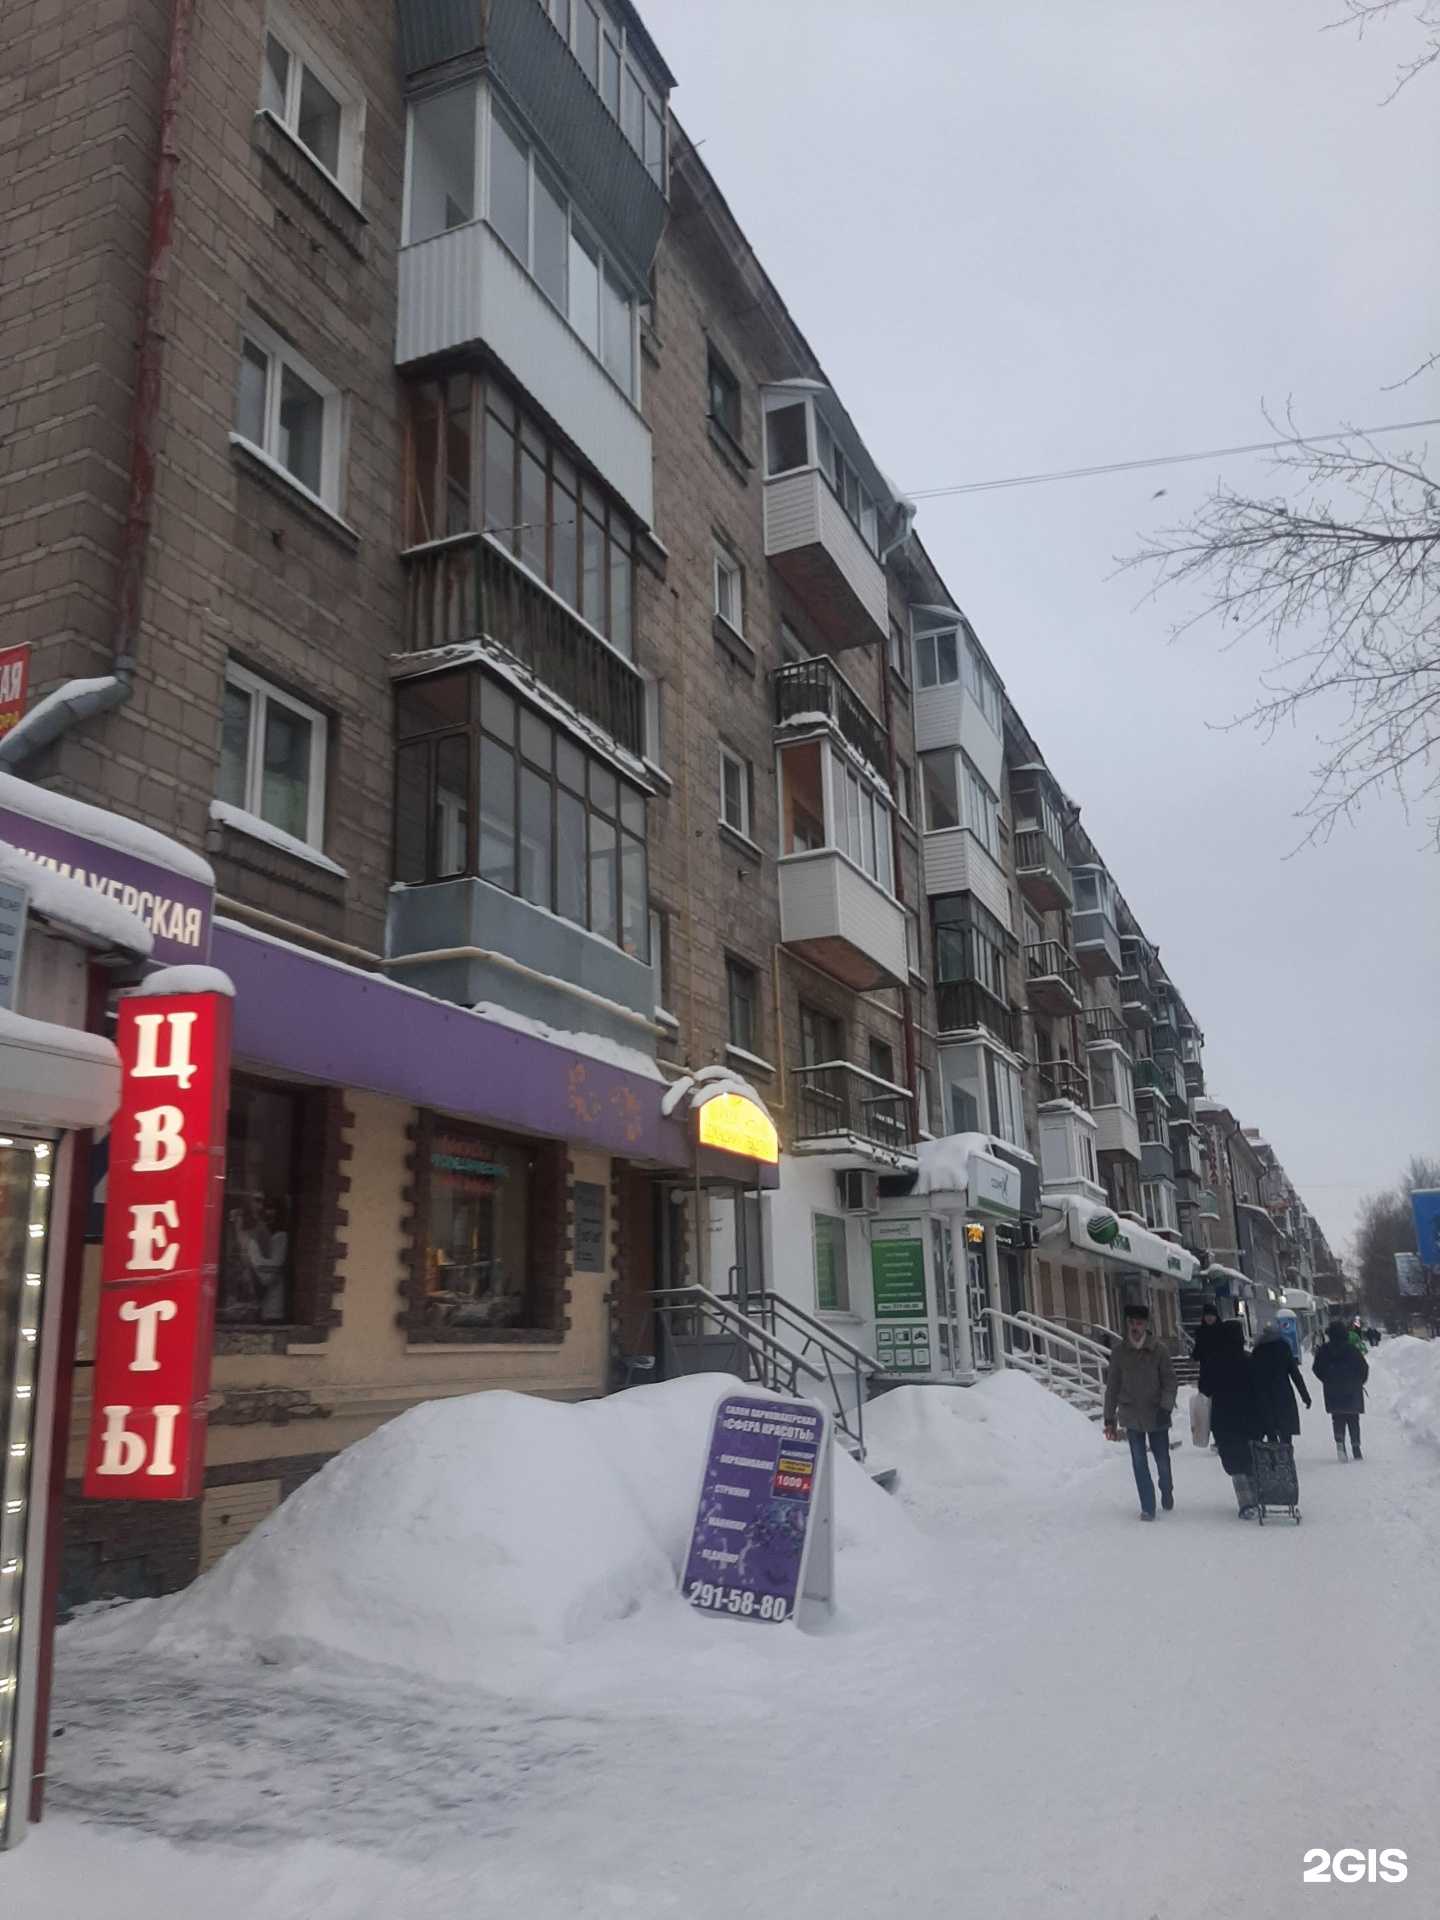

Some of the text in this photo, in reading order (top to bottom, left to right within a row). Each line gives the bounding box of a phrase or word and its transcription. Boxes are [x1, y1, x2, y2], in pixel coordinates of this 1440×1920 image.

[96, 1011, 198, 1476] ЦВЕТЫ
[723, 1417, 815, 1441] «СФЕРА КРАСОТЫ»
[690, 1581, 787, 1621] 291-58-80
